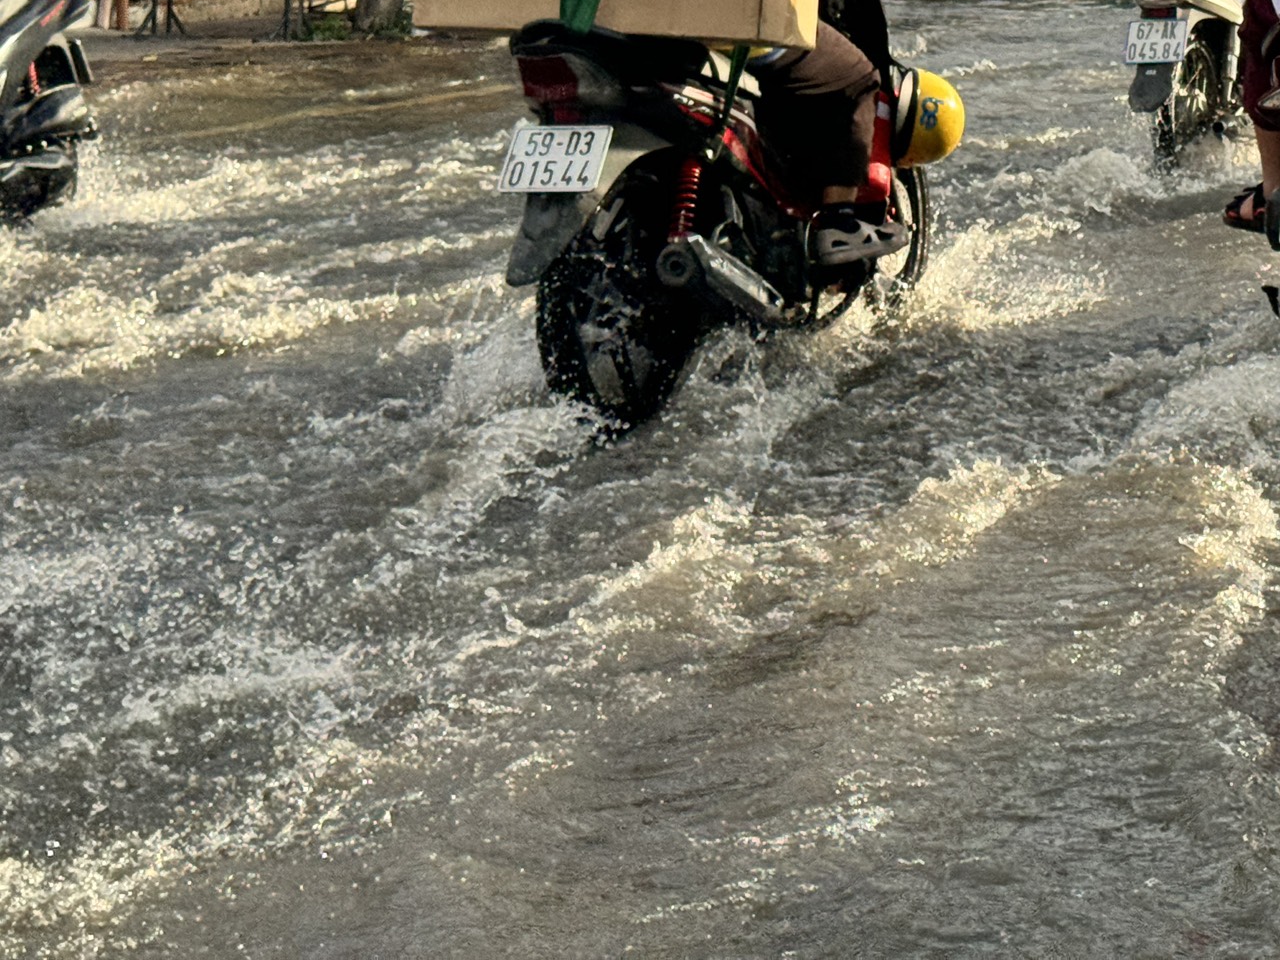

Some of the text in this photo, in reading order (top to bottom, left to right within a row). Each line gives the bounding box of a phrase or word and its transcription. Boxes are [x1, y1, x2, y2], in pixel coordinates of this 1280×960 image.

[1128, 41, 1181, 60] 045.84
[525, 131, 596, 156] 59-D3
[508, 160, 590, 186] 015.44
